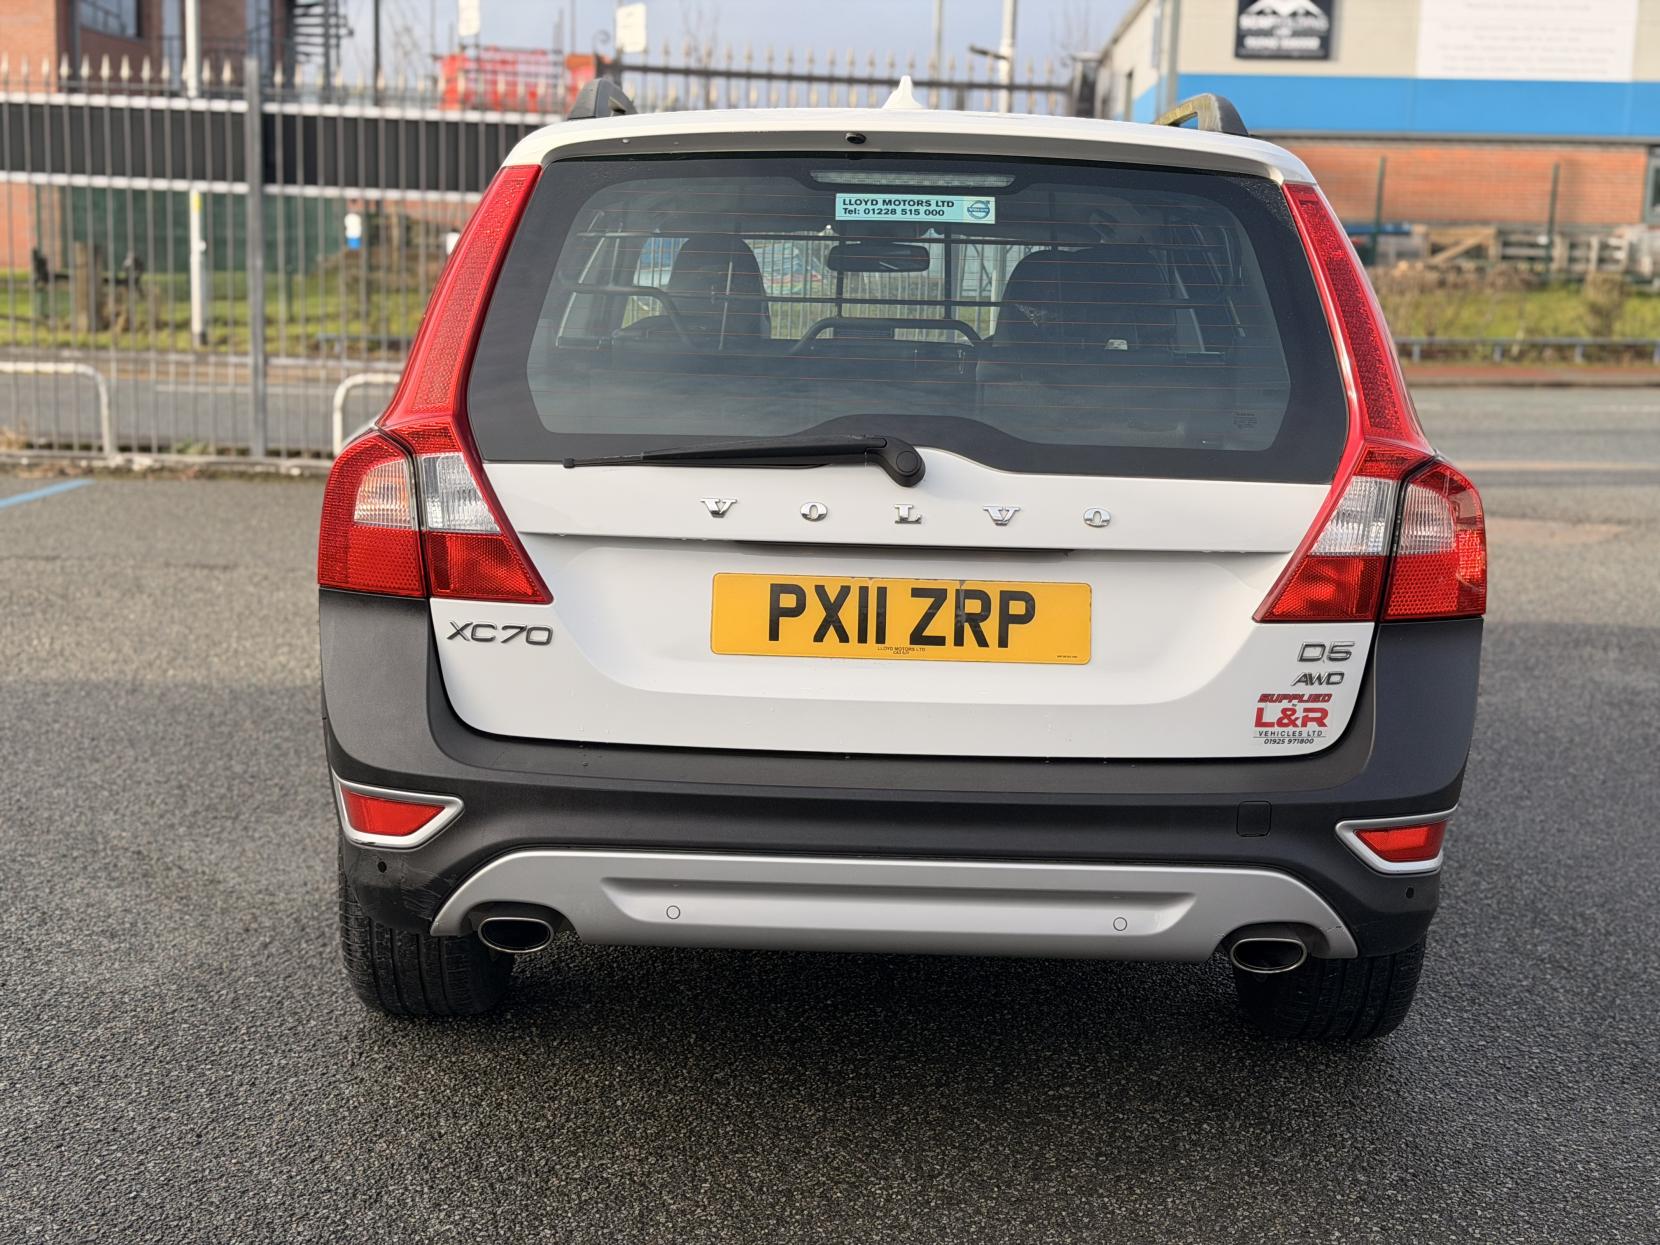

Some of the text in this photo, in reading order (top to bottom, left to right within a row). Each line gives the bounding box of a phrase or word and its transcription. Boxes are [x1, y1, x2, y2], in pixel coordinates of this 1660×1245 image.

[842, 198, 955, 208] LLOYD MOTORS LTD
[842, 207, 945, 217] Tel: 01228 515 000
[700, 497, 1112, 528] VOLVO
[768, 583, 1036, 649] PX11 ZRP
[446, 620, 554, 646] XC70
[1297, 640, 1355, 663] D5
[1291, 671, 1345, 686] AWD
[1258, 693, 1333, 703] SUPPLIED
[1254, 707, 1329, 728] L&R
